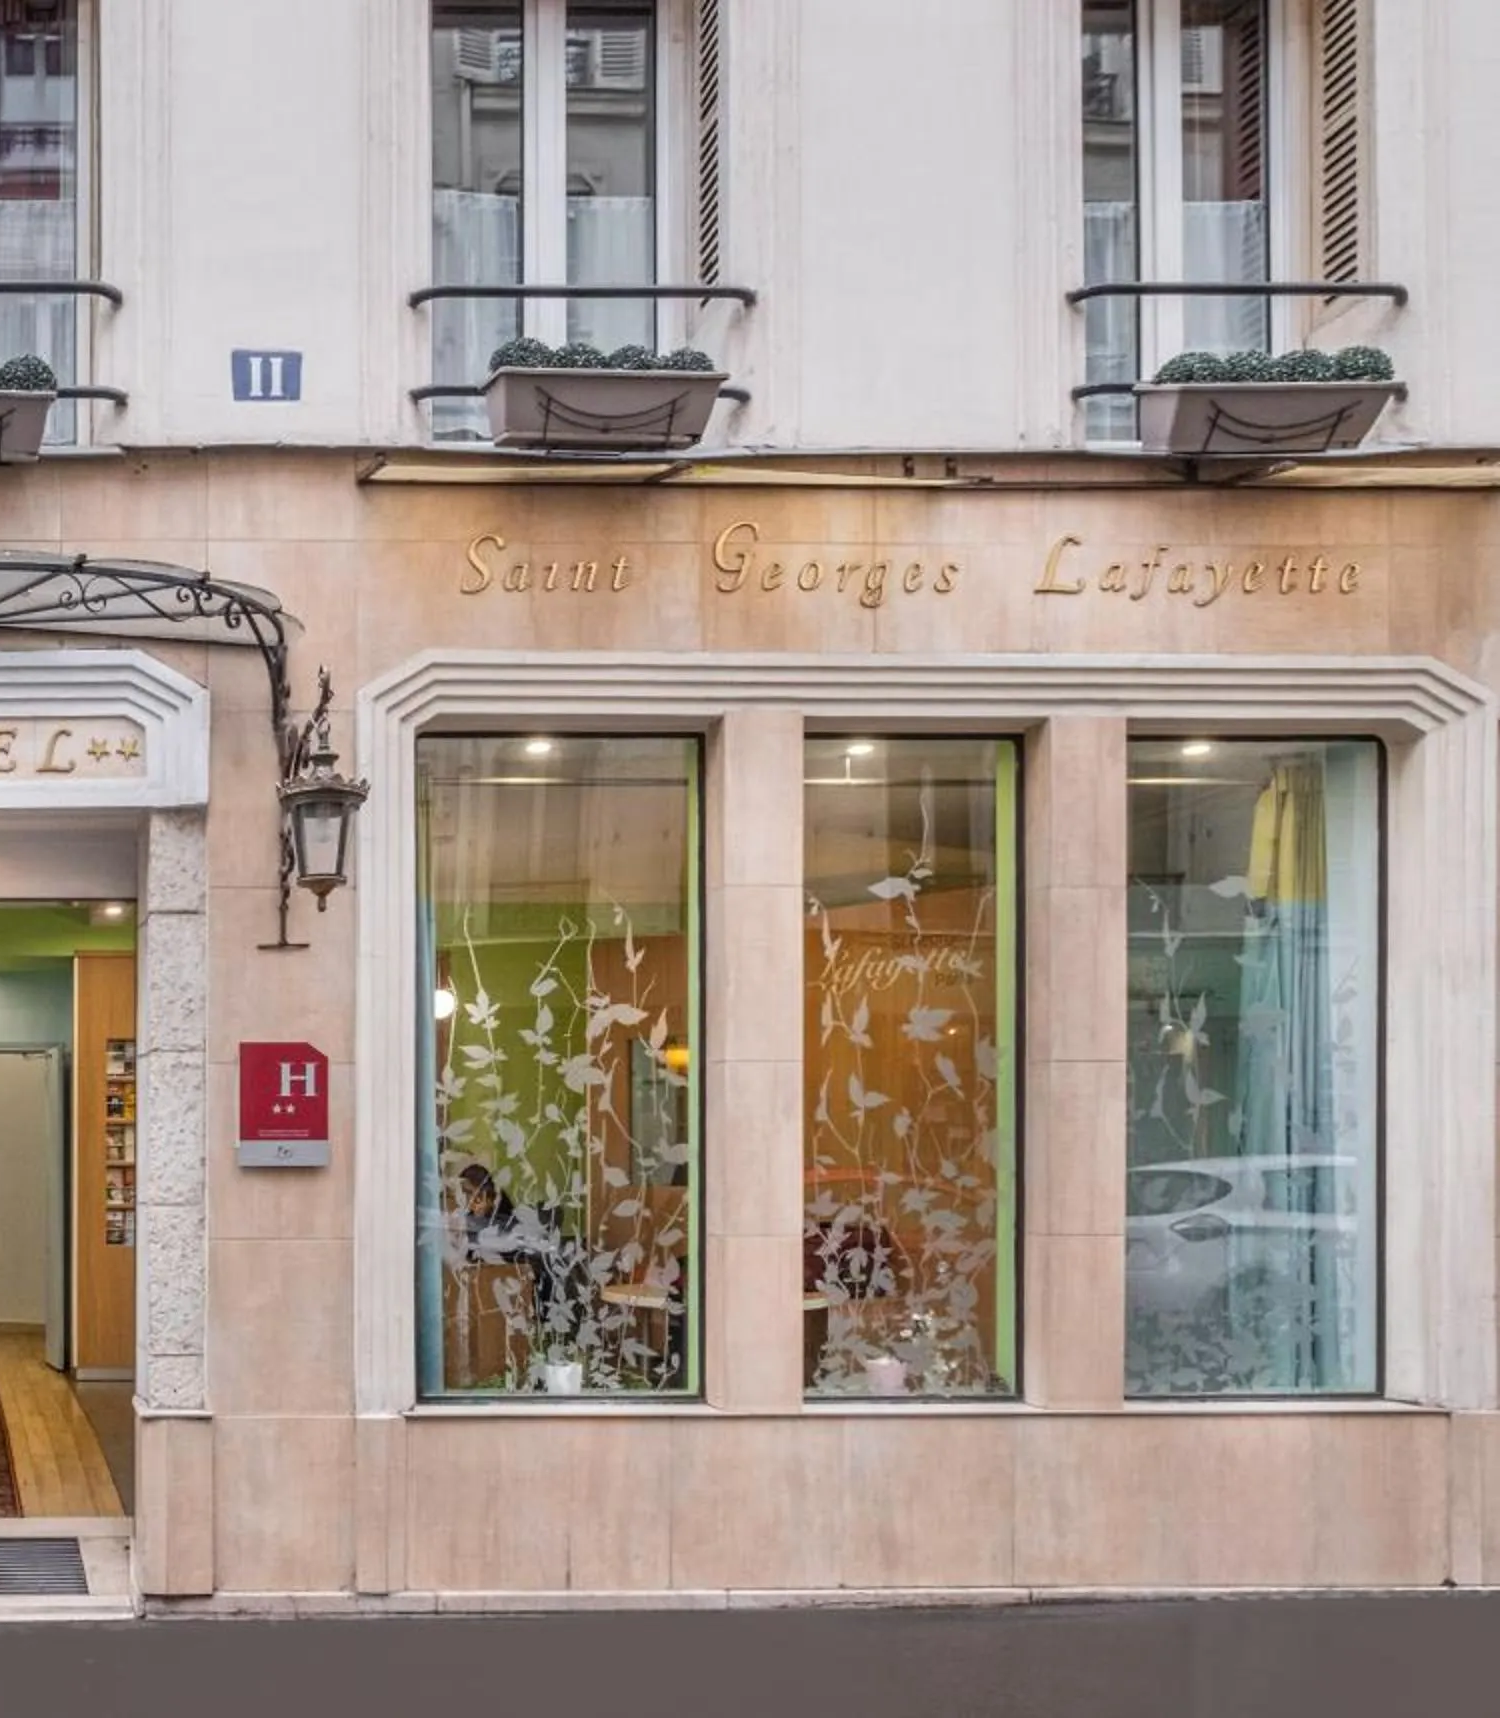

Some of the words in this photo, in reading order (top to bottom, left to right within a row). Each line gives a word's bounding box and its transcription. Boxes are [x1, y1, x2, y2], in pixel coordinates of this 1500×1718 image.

[248, 357, 283, 397] 11
[459, 532, 634, 597] Saint
[711, 521, 961, 608] Georges
[1031, 535, 1363, 608] Lafayette
[818, 946, 967, 994] Lafaytte
[277, 1061, 320, 1097] H
